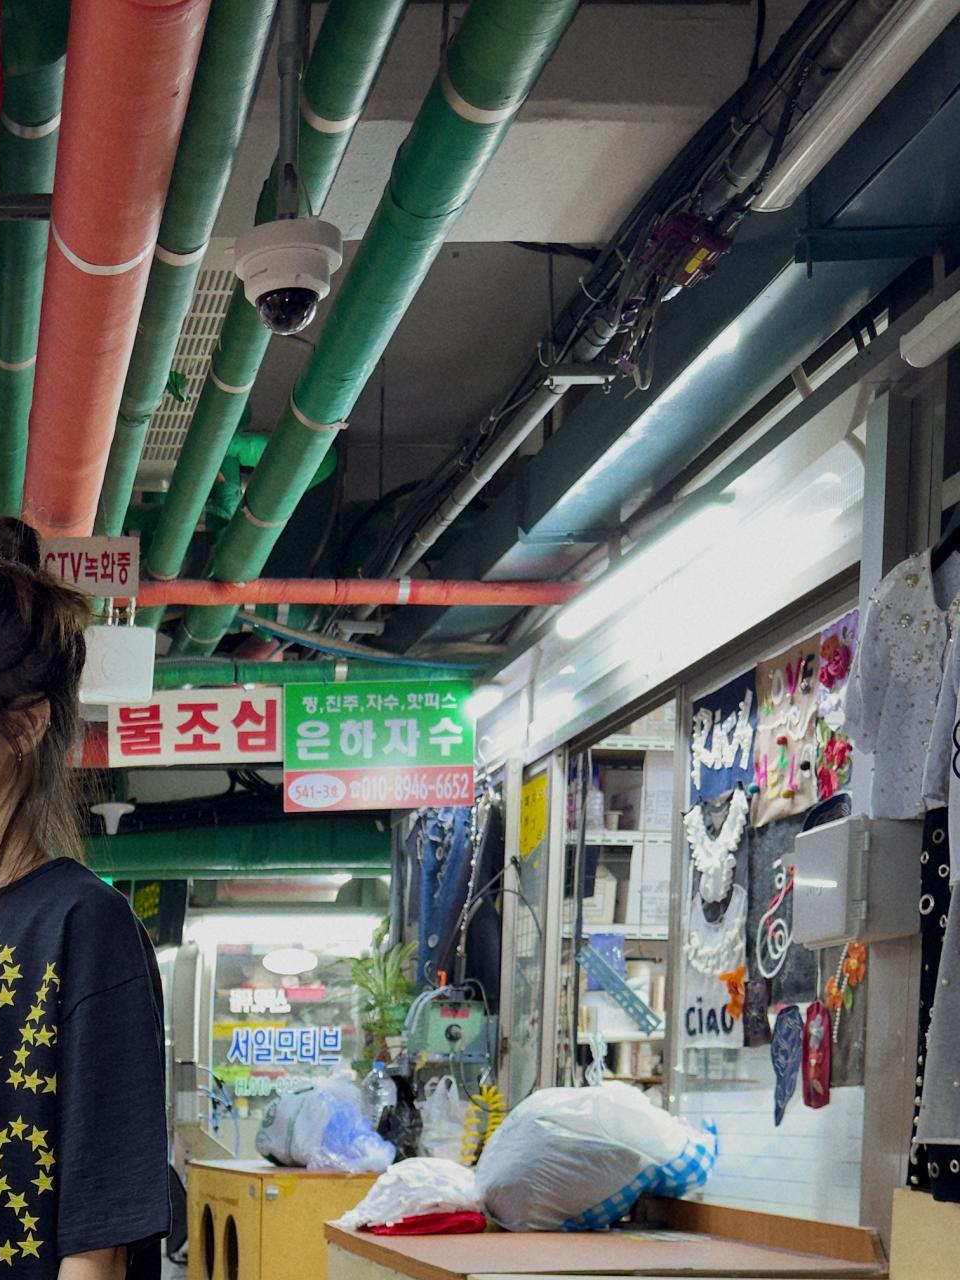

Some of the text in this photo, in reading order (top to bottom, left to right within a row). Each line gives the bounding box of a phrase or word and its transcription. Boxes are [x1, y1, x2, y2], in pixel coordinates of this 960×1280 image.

[116, 699, 278, 757] 불조심
[295, 716, 464, 762] 은하자수
[360, 773, 470, 802] 010-8946-6652
[227, 1028, 341, 1064] 서일모티브
